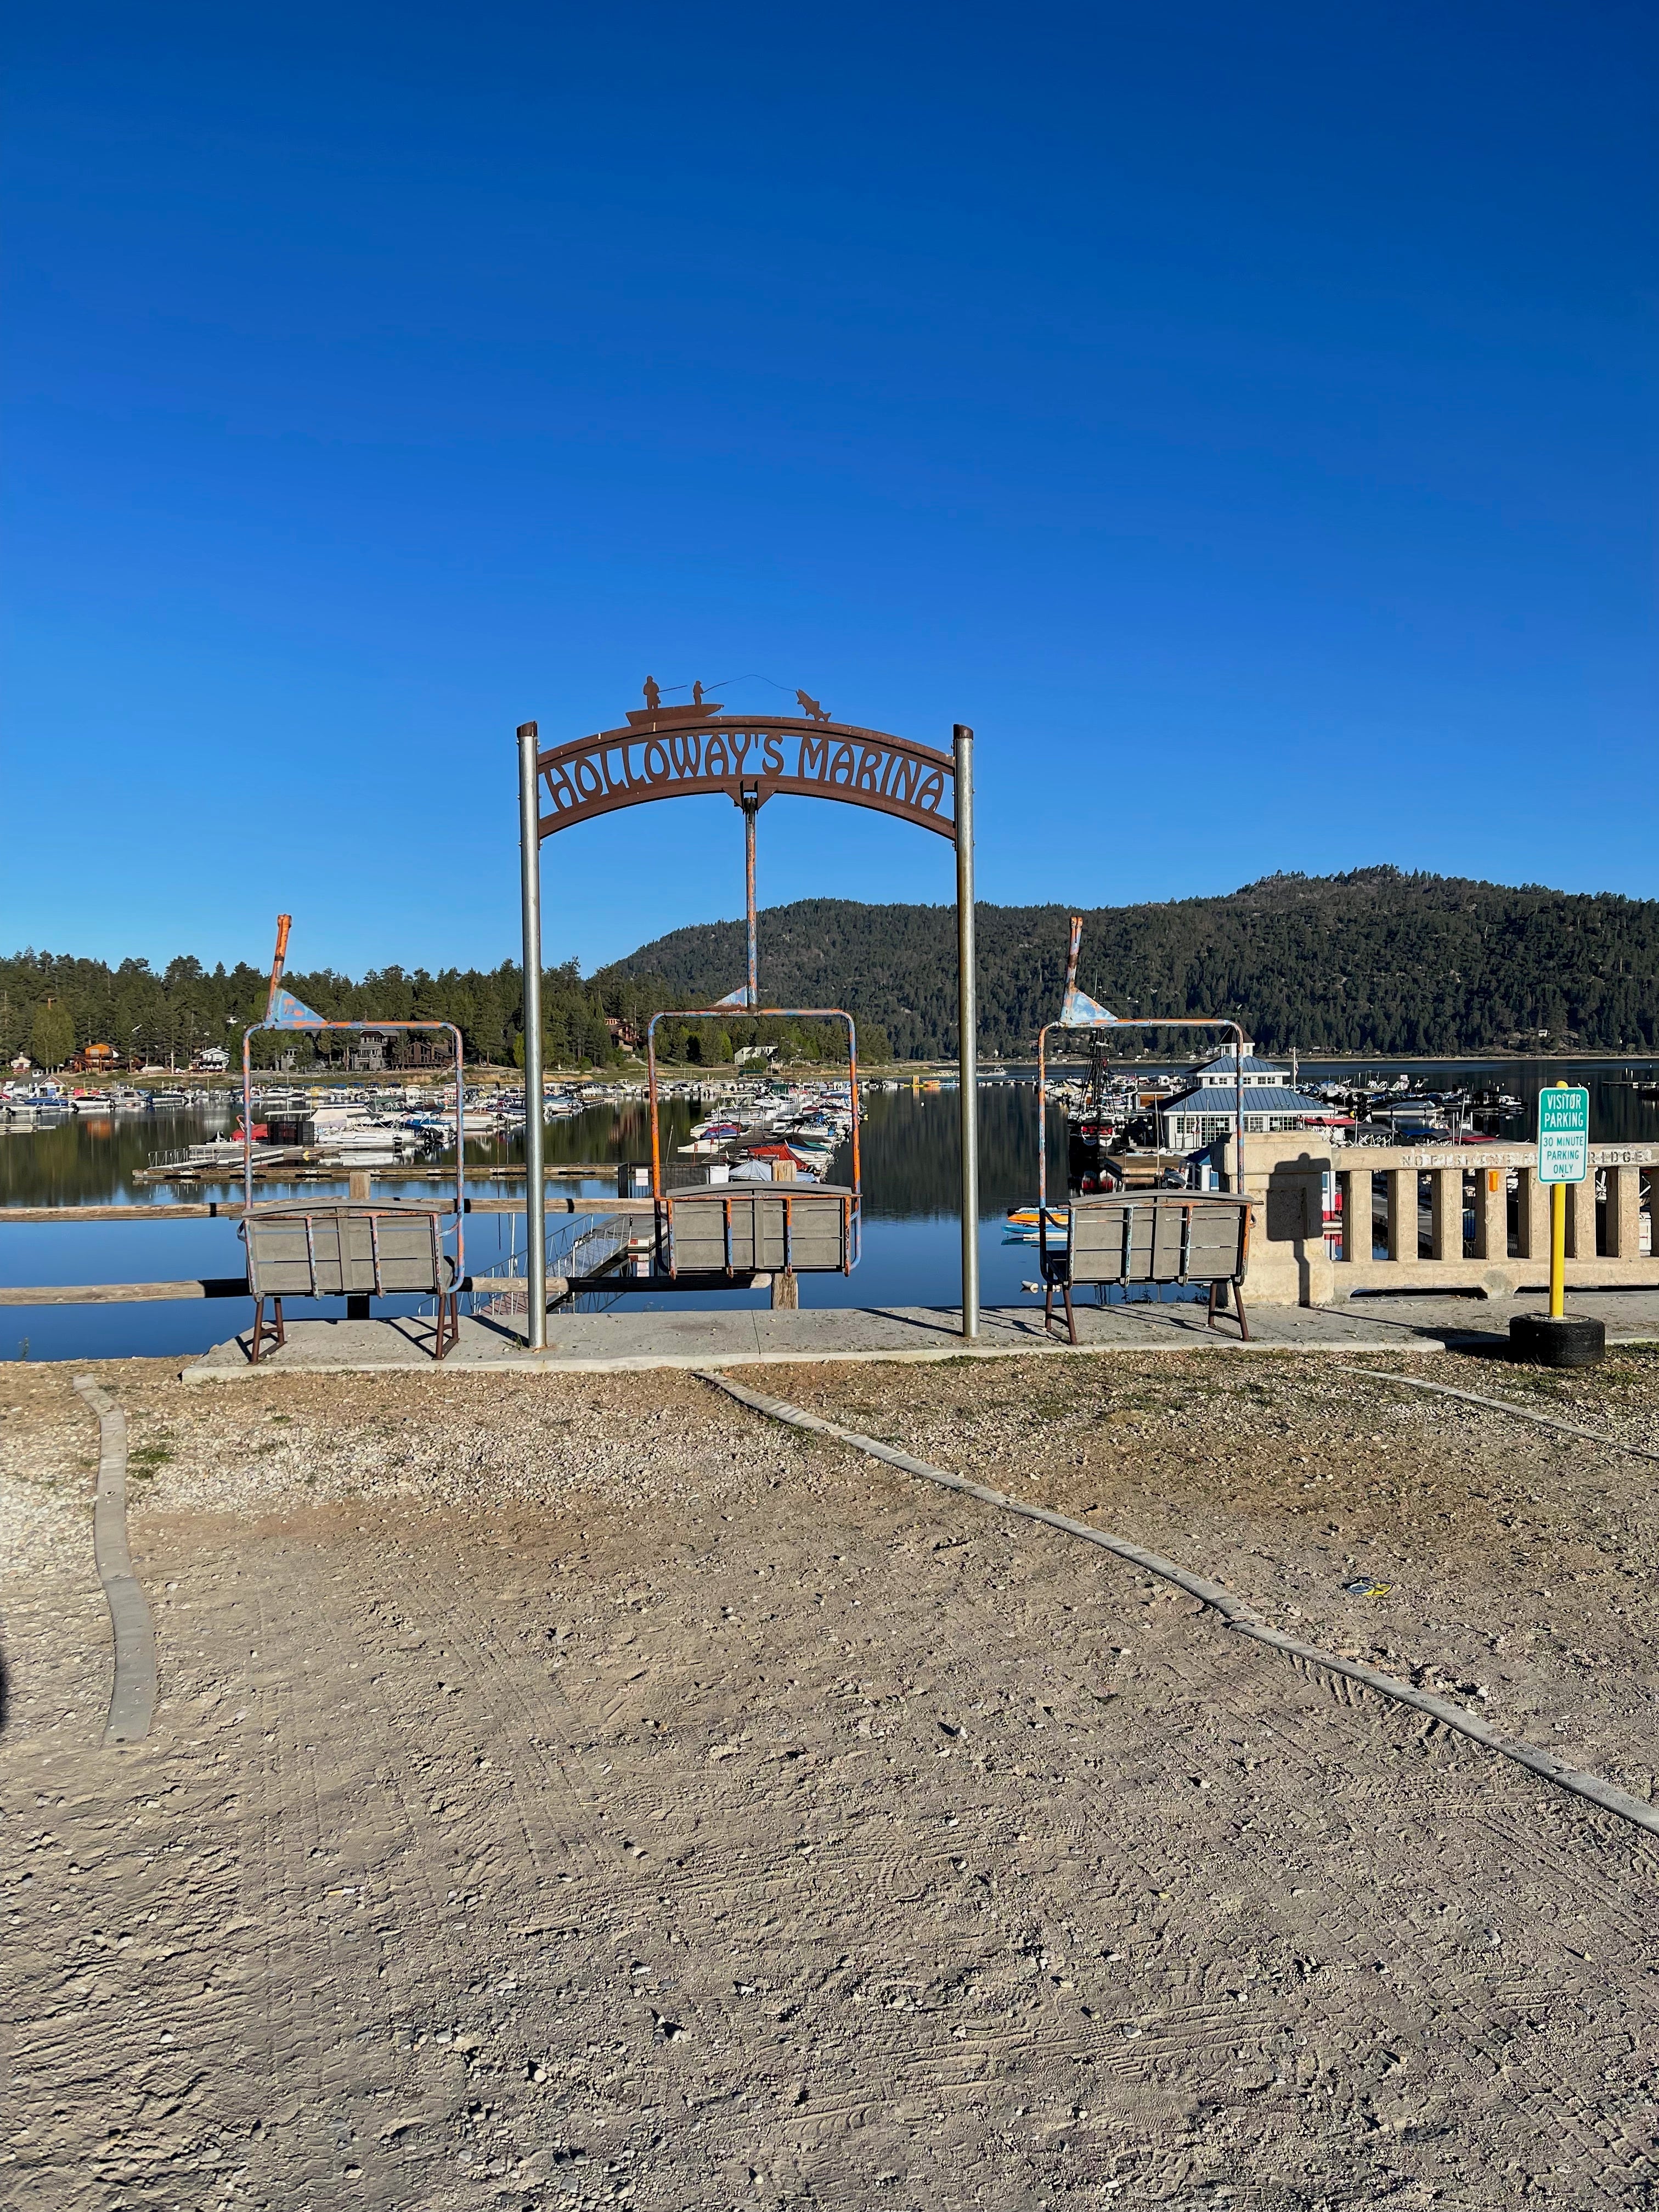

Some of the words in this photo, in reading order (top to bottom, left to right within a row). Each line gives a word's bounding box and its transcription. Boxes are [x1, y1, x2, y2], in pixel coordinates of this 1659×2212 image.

[543, 732, 785, 811] HOLLOWAY'S
[798, 737, 945, 813] MARINA
[1547, 1093, 1581, 1110] VISITOR
[1544, 1111, 1584, 1128] PARKING
[1543, 1137, 1553, 1147] 30
[1556, 1136, 1584, 1146] MINUTE
[1547, 1150, 1579, 1160] PARKING
[1553, 1164, 1573, 1174] ONLY
